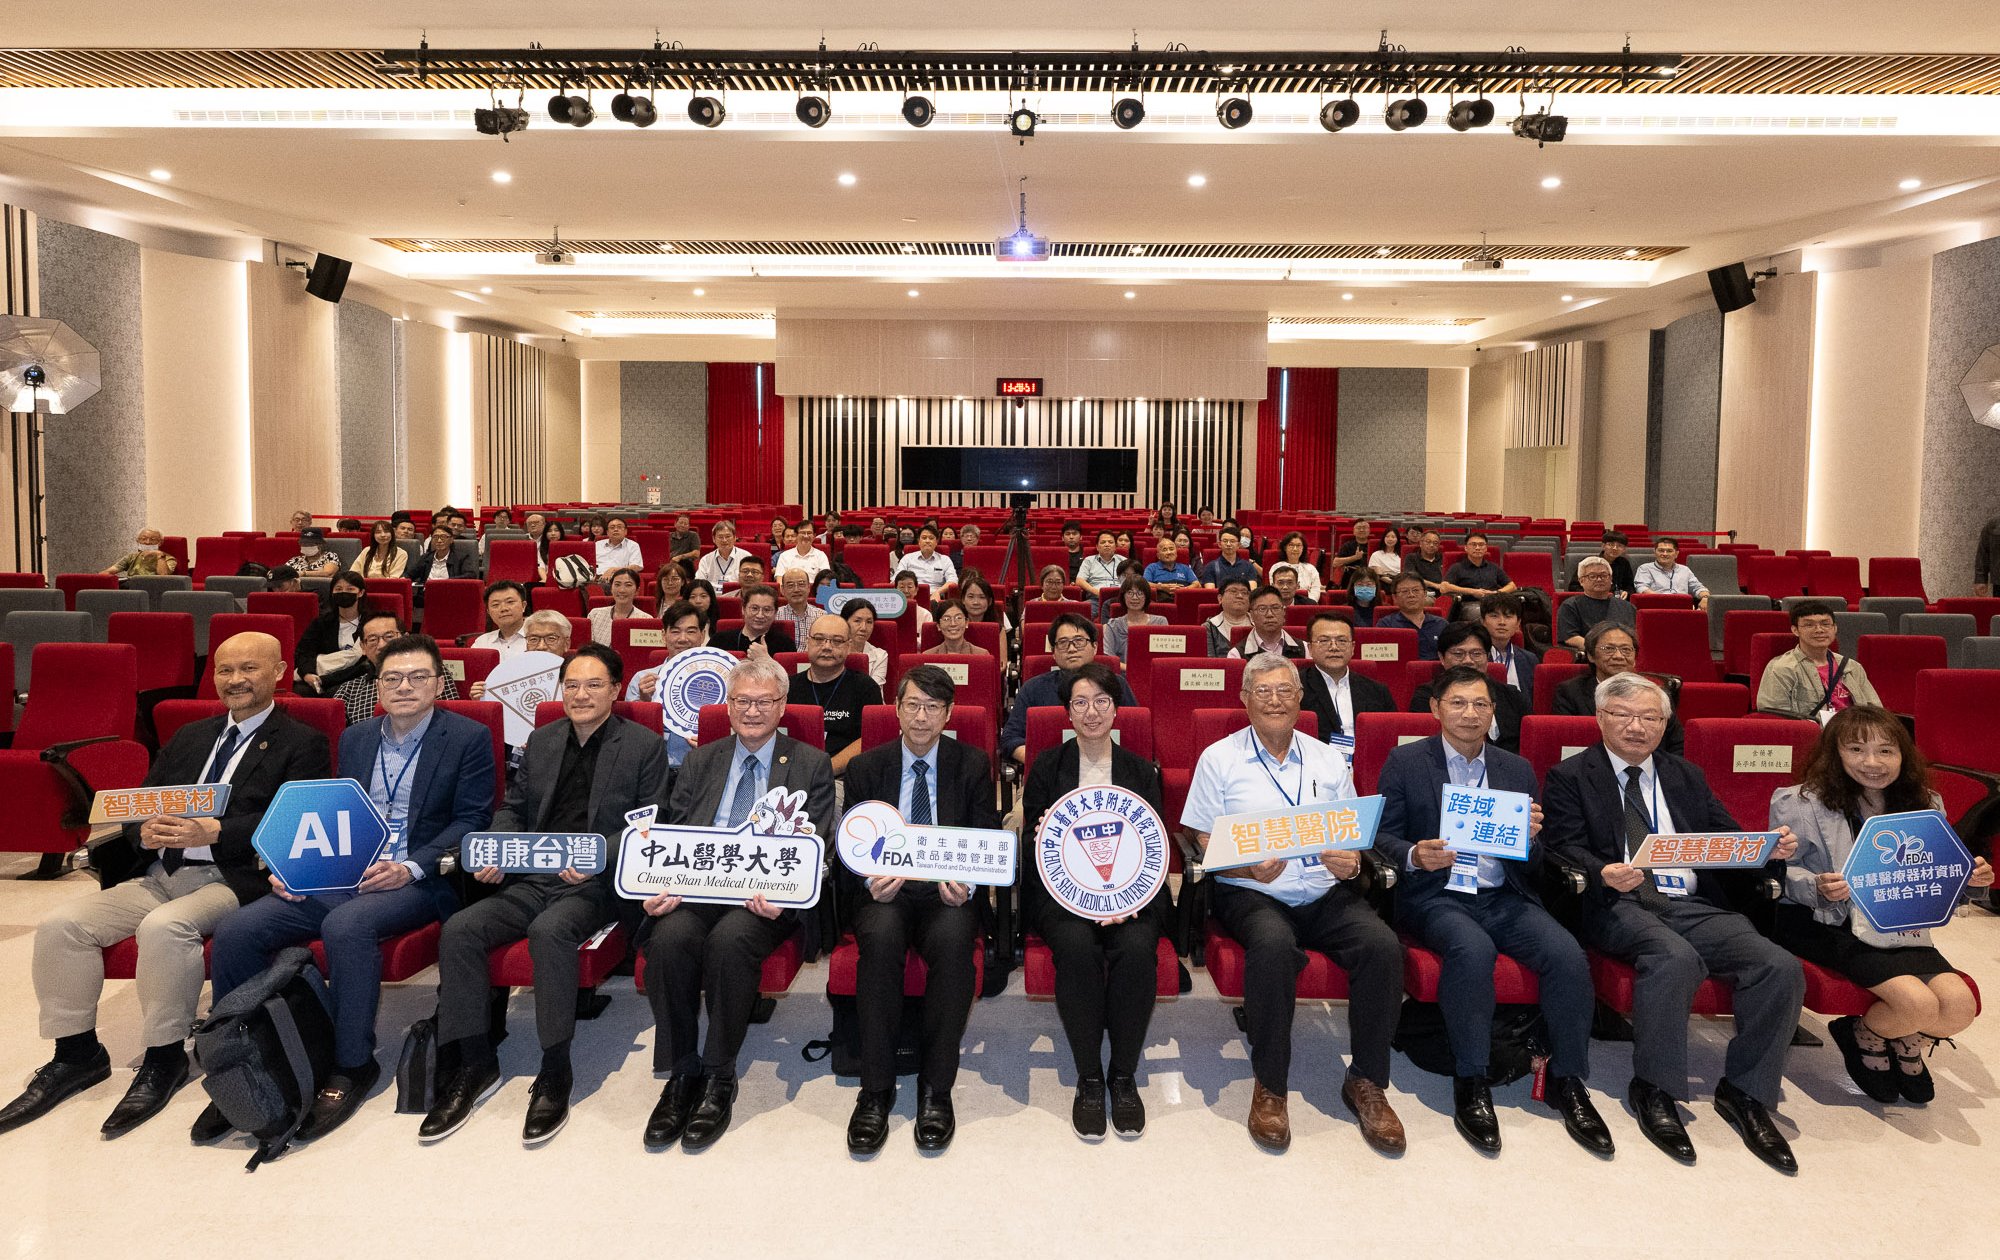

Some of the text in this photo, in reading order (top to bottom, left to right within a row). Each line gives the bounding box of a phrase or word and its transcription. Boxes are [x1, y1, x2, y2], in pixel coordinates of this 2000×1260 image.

[501, 672, 554, 695] 國立中興大學
[671, 684, 689, 717] TUNGHAI
[103, 787, 216, 817] 智慧醫材
[1446, 792, 1496, 818] 跨域
[288, 810, 352, 859] AI
[917, 836, 1009, 851] 衛生福利部
[1230, 807, 1361, 856] 智慧醫院
[1470, 820, 1520, 847] 連結
[468, 836, 598, 869] 健康台灣
[640, 840, 801, 876] 中山醫學大學
[882, 851, 914, 867] FDA
[916, 850, 1008, 866] 食品藥物管理署
[1649, 836, 1765, 863] 智慧醫材
[959, 865, 972, 873] Drug
[971, 866, 1008, 874] Administration
[1043, 830, 1162, 912] CHUNG SHAN MEDICAL UNIVERSITY HOSPITAL
[1851, 864, 1964, 889] 智慧醫療器材資訊
[637, 871, 799, 895] Chung Shan Medical University
[1873, 882, 1942, 902] 暨媒合平台
